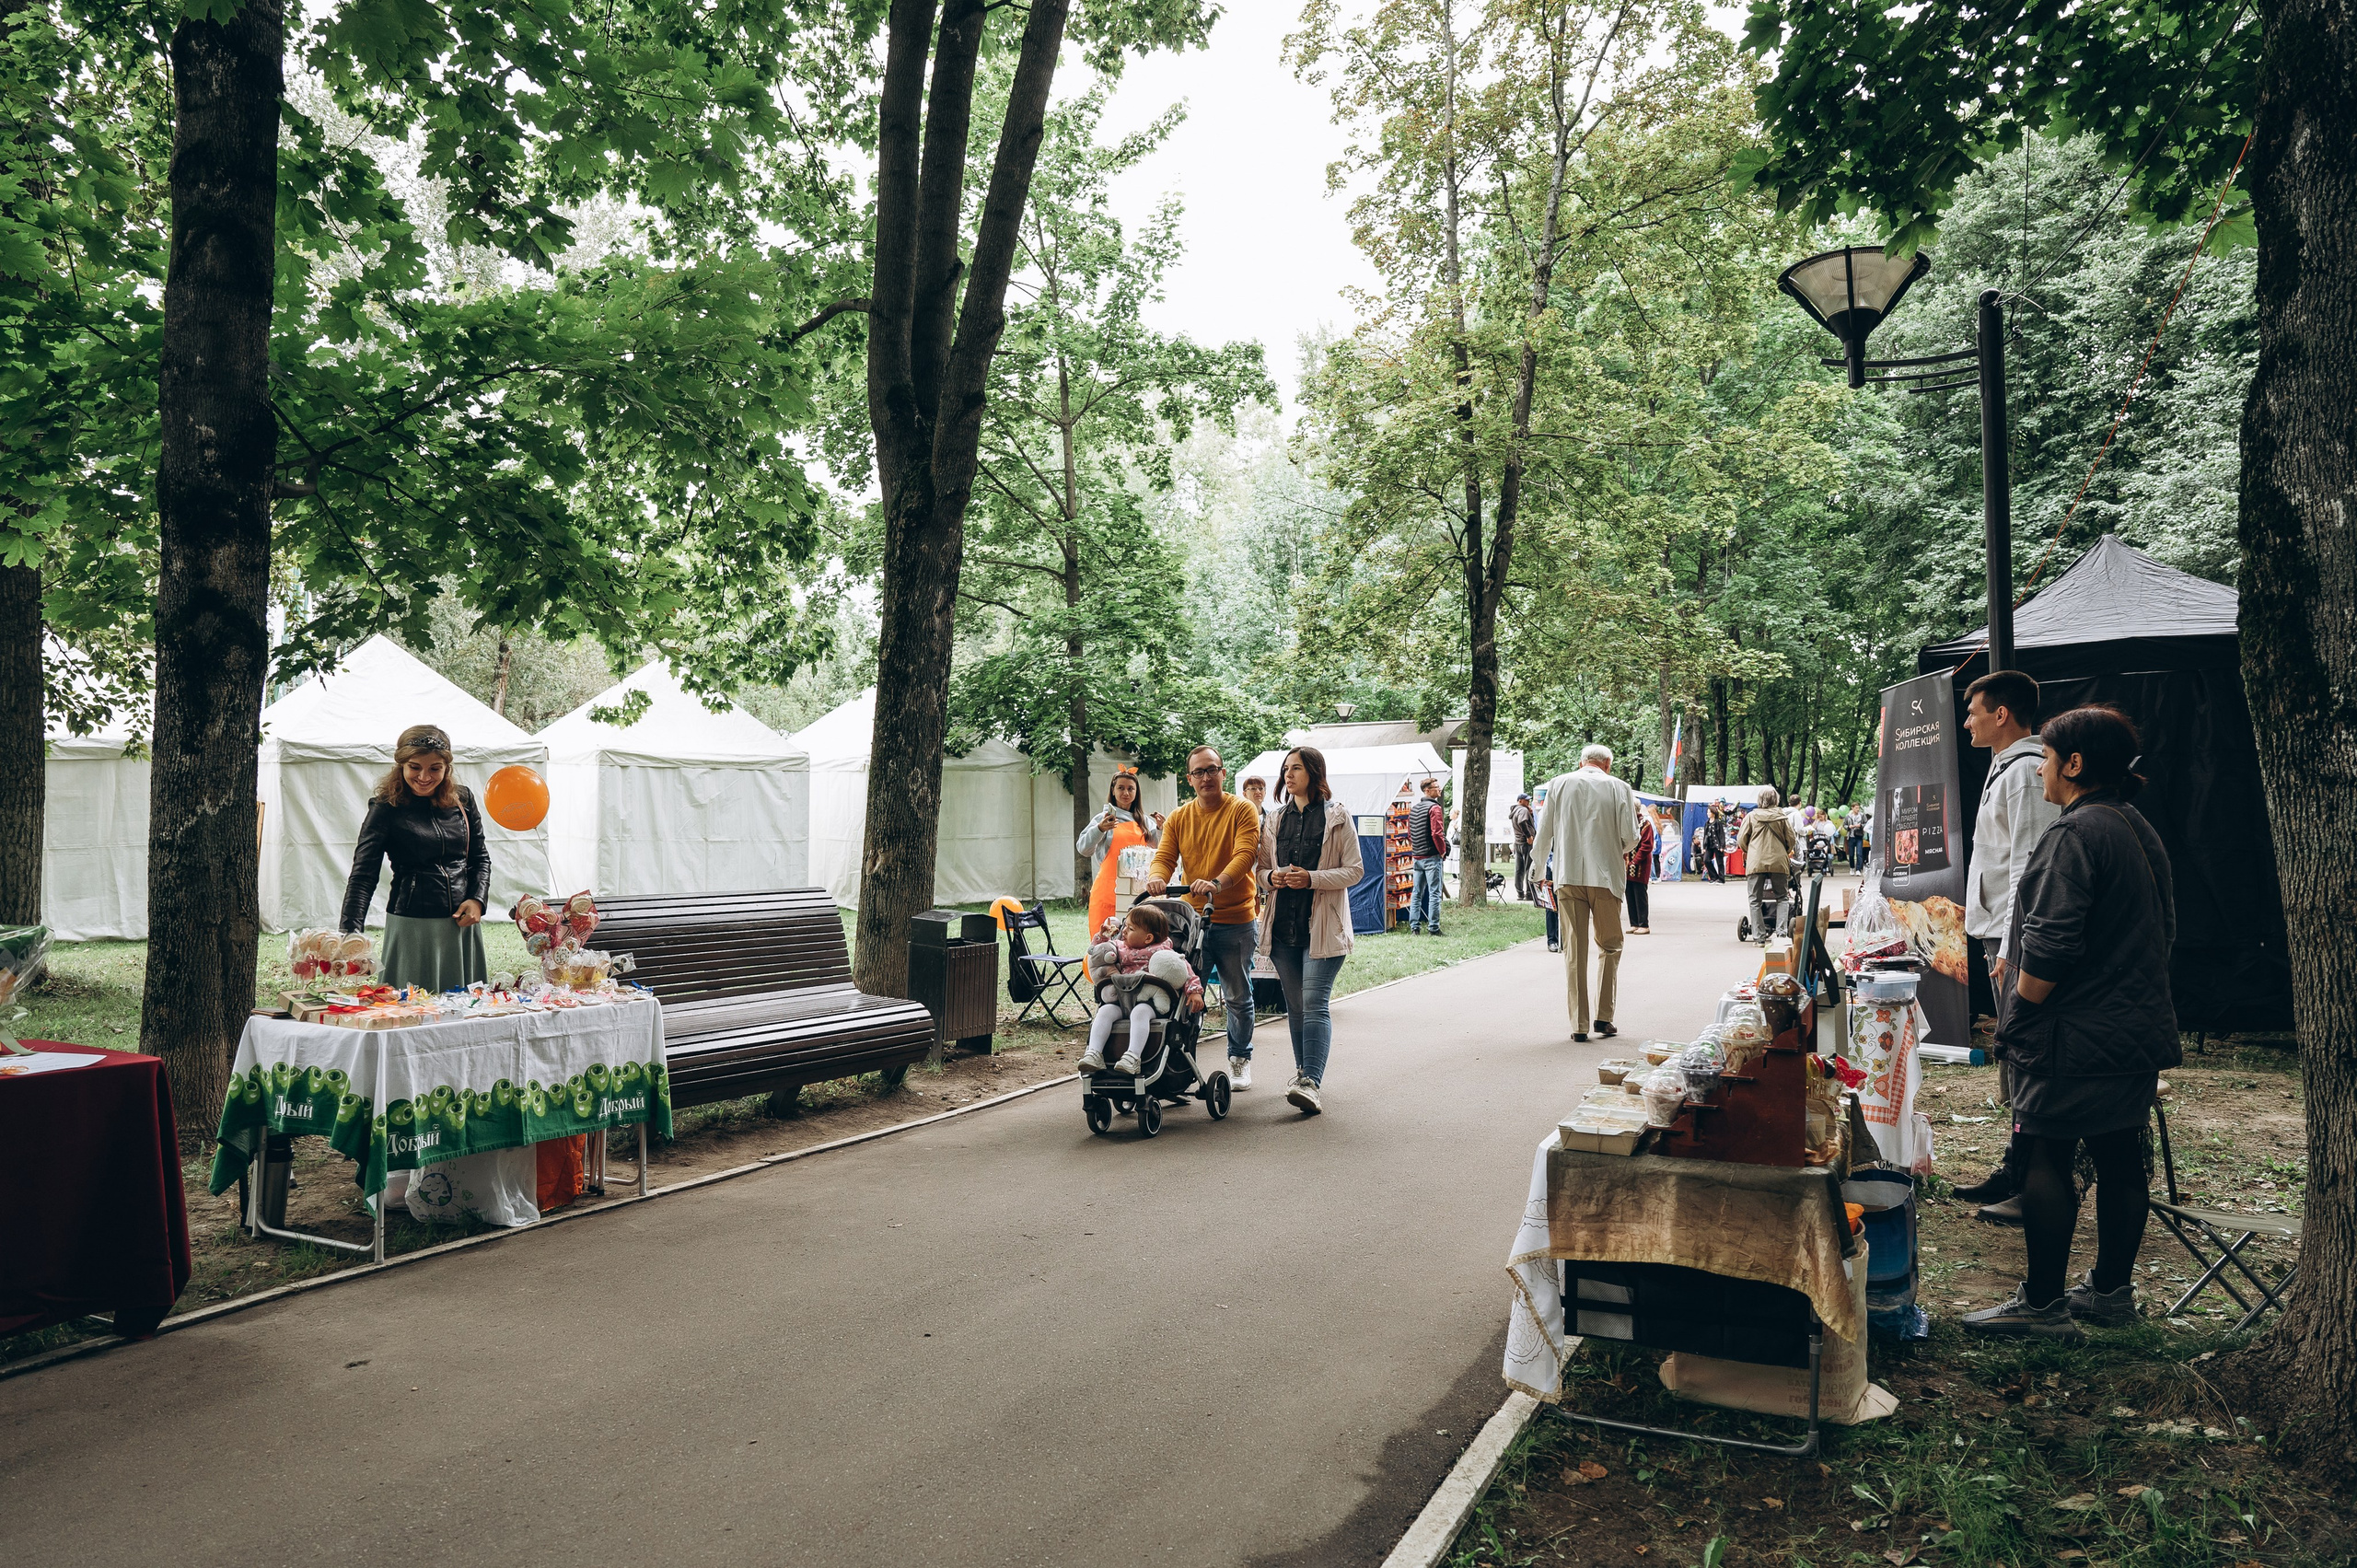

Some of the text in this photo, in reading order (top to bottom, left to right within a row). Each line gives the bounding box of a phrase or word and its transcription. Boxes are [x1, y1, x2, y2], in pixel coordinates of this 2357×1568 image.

[1895, 734, 1941, 751] КОЛЛЕКЦИЯ
[1922, 826, 1943, 836] PIZZA
[598, 1090, 645, 1121] Добрый
[387, 1124, 441, 1159] Добрый
